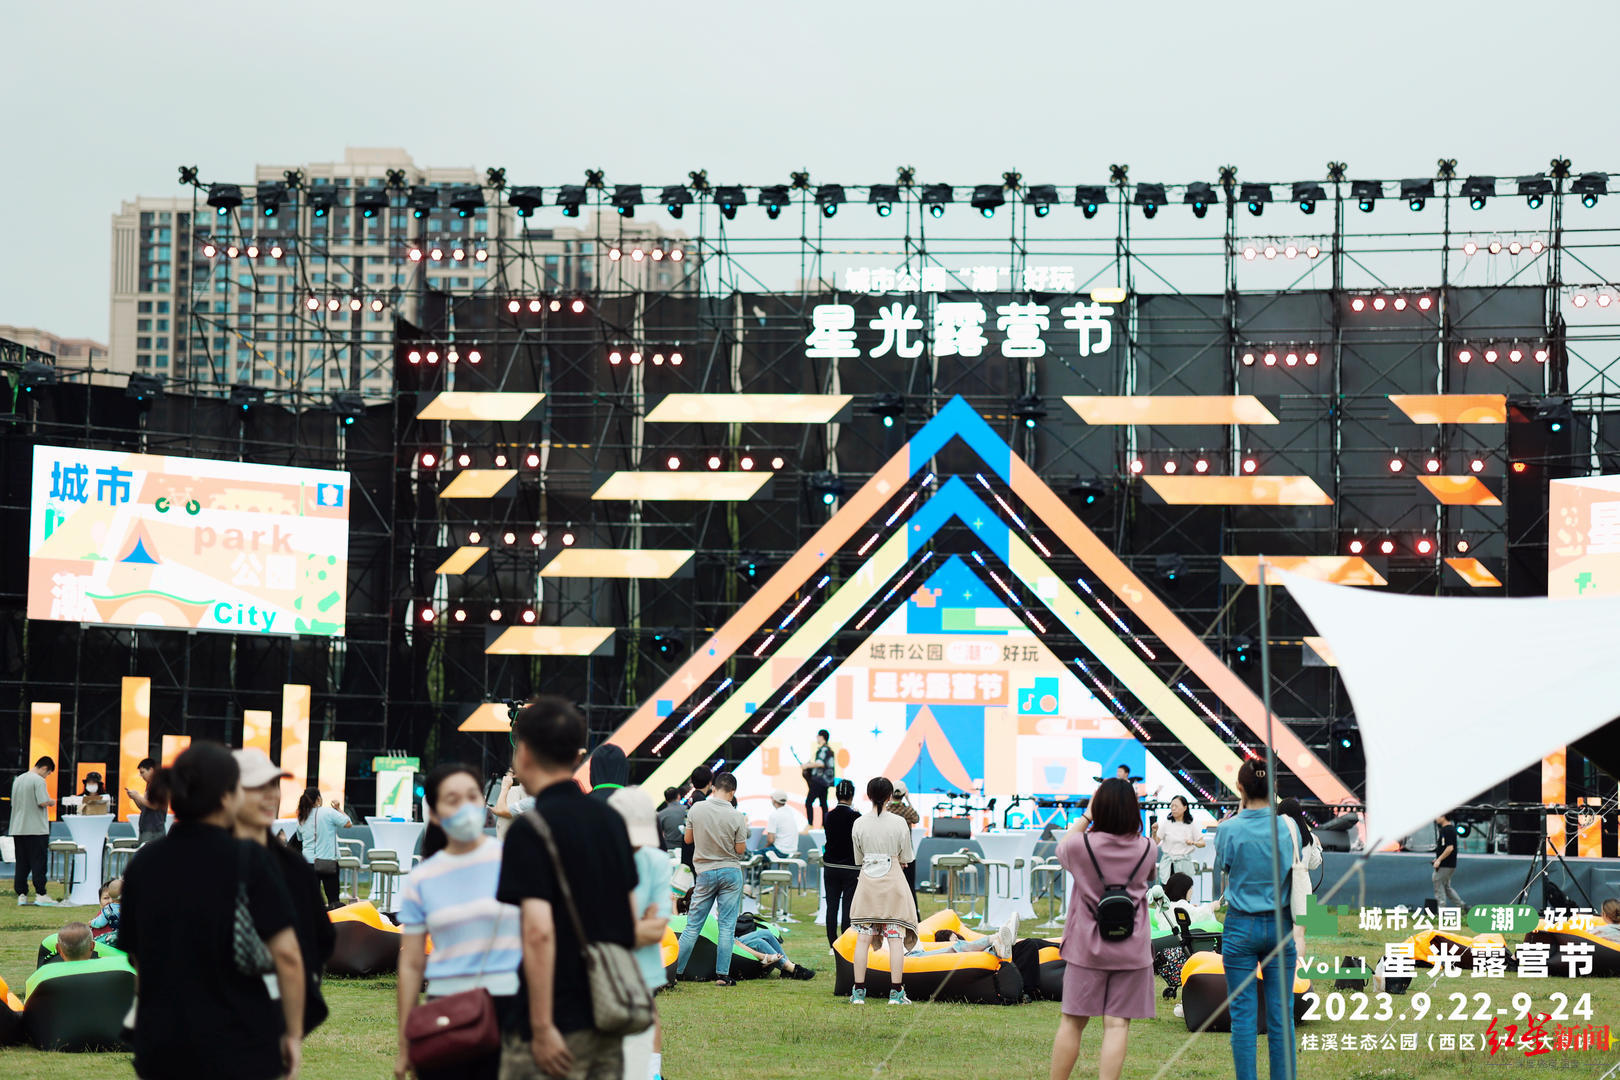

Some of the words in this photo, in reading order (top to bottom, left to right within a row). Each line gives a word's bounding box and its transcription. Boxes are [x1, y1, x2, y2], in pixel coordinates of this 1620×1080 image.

[805, 302, 1115, 358] 星光露营节
[50, 461, 133, 506] 城市
[193, 524, 294, 555] park
[231, 553, 297, 590] 公园
[213, 602, 277, 633] City
[873, 672, 1004, 700] 星光露营节
